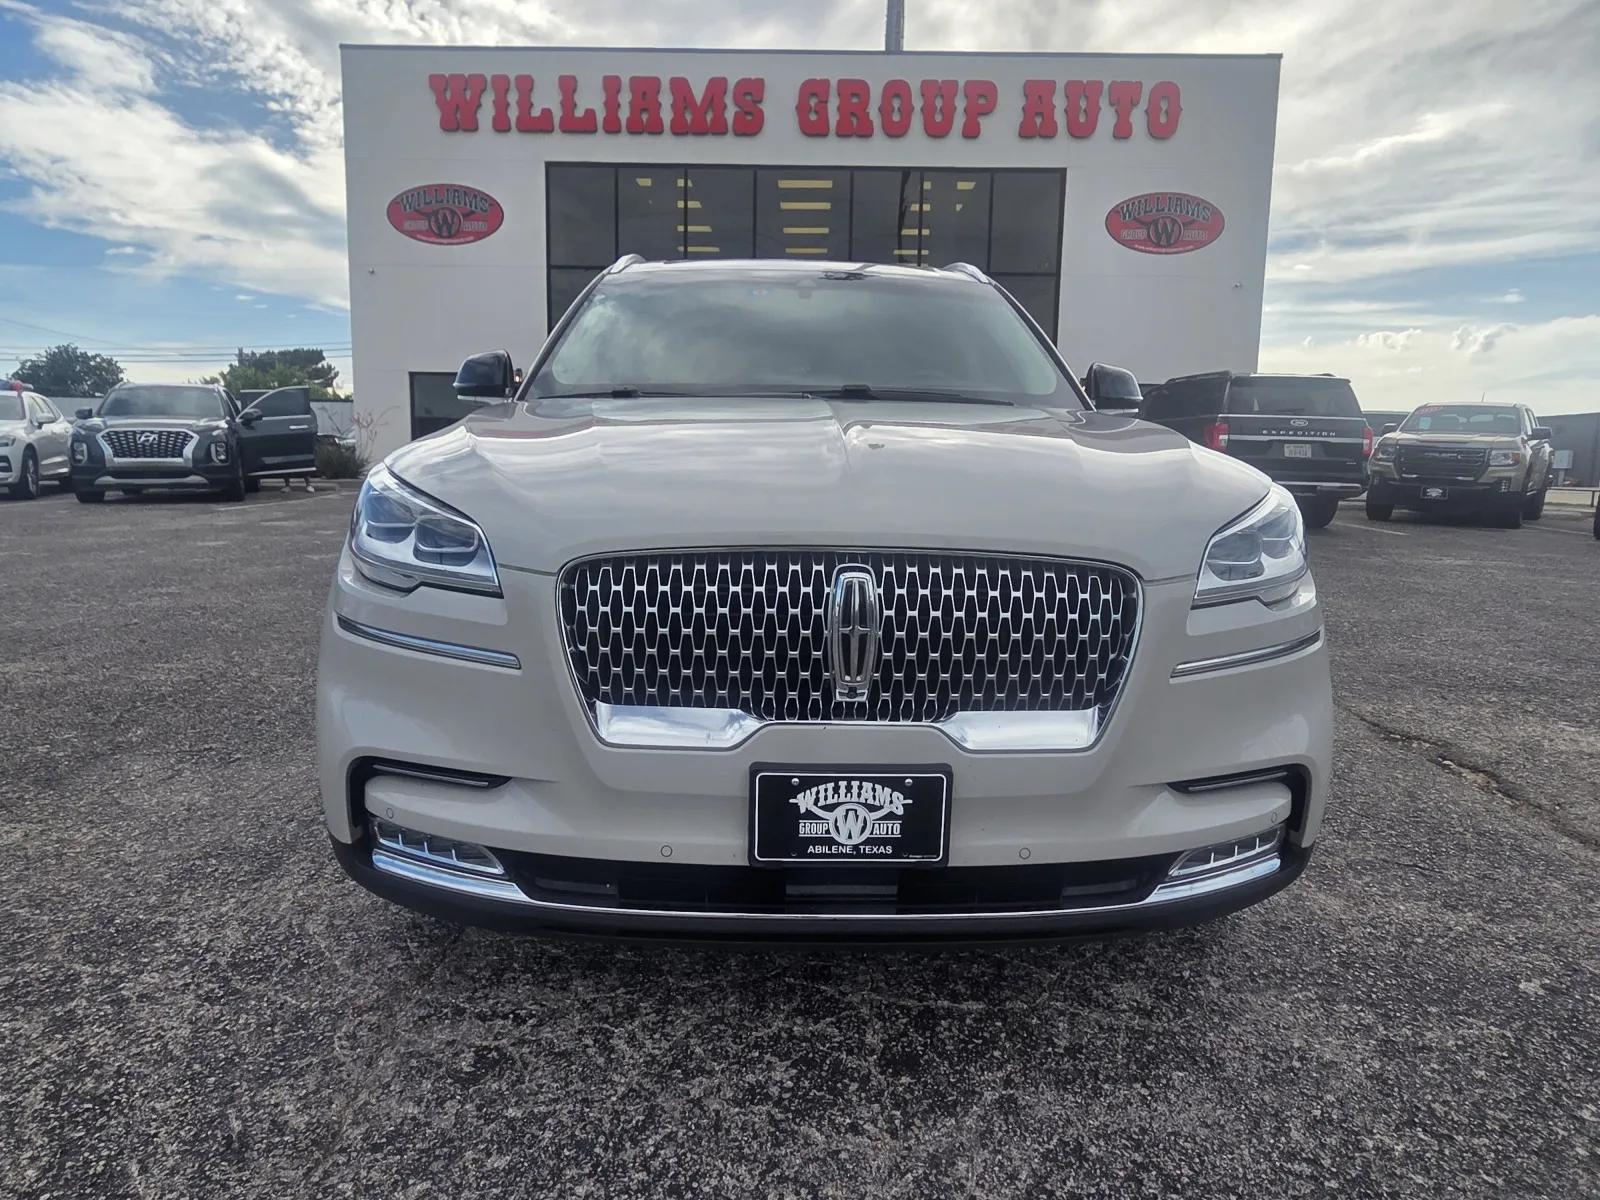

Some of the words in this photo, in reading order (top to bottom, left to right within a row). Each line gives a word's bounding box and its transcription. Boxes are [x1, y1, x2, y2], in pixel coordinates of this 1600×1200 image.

[428, 73, 766, 137] WILLIAMS
[795, 77, 999, 138] GROUP
[1018, 79, 1184, 140] AUTO
[400, 187, 490, 214] WILLIAMS
[1119, 194, 1212, 222] WILLIAMS
[1262, 429, 1336, 437] EXPEDITION
[797, 780, 904, 816] WILLIAMS
[799, 822, 829, 835] GROUP
[836, 808, 866, 840] W
[872, 823, 901, 836] AUTO
[807, 845, 856, 855] ABILENE,
[859, 845, 893, 854] TEXAS
